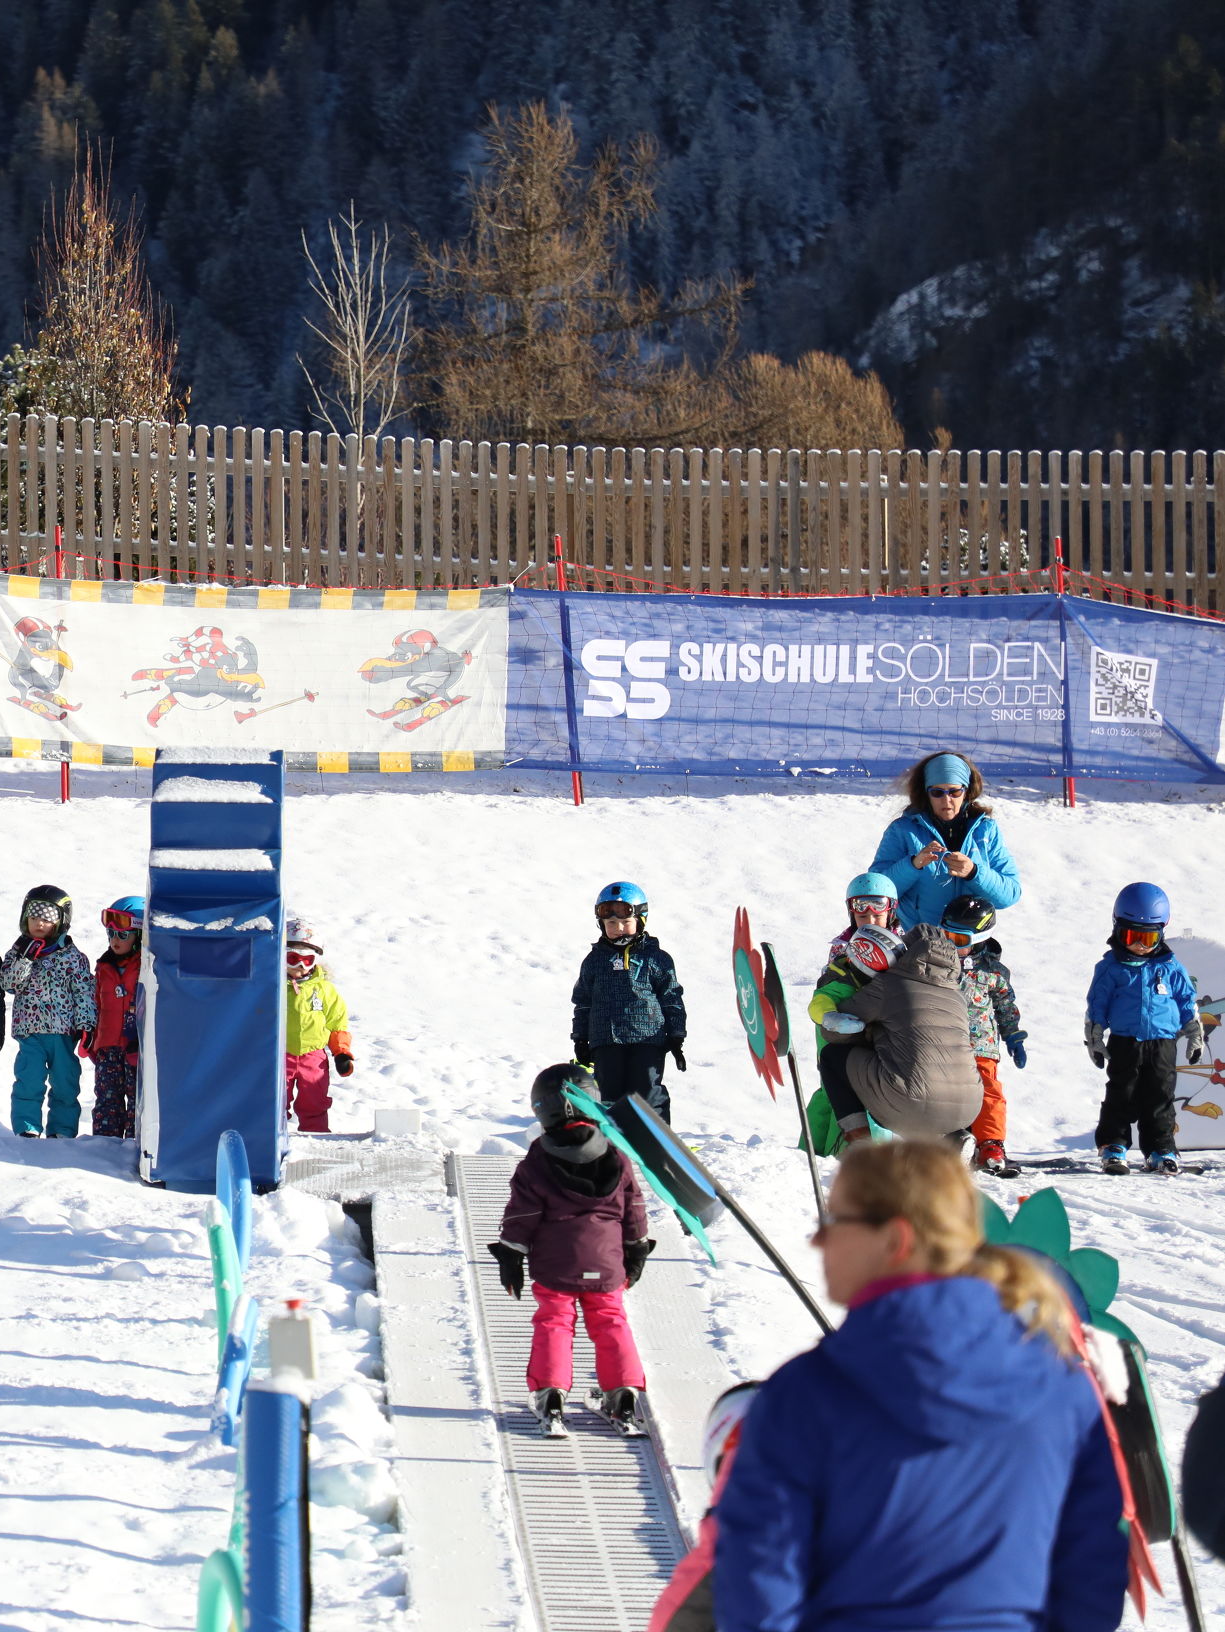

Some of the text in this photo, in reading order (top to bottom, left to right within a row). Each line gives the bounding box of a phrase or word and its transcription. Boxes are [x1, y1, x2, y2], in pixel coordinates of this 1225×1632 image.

[898, 681, 1064, 707] HOCHSÖLDEN
[991, 708, 1066, 721] SINCE 1928
